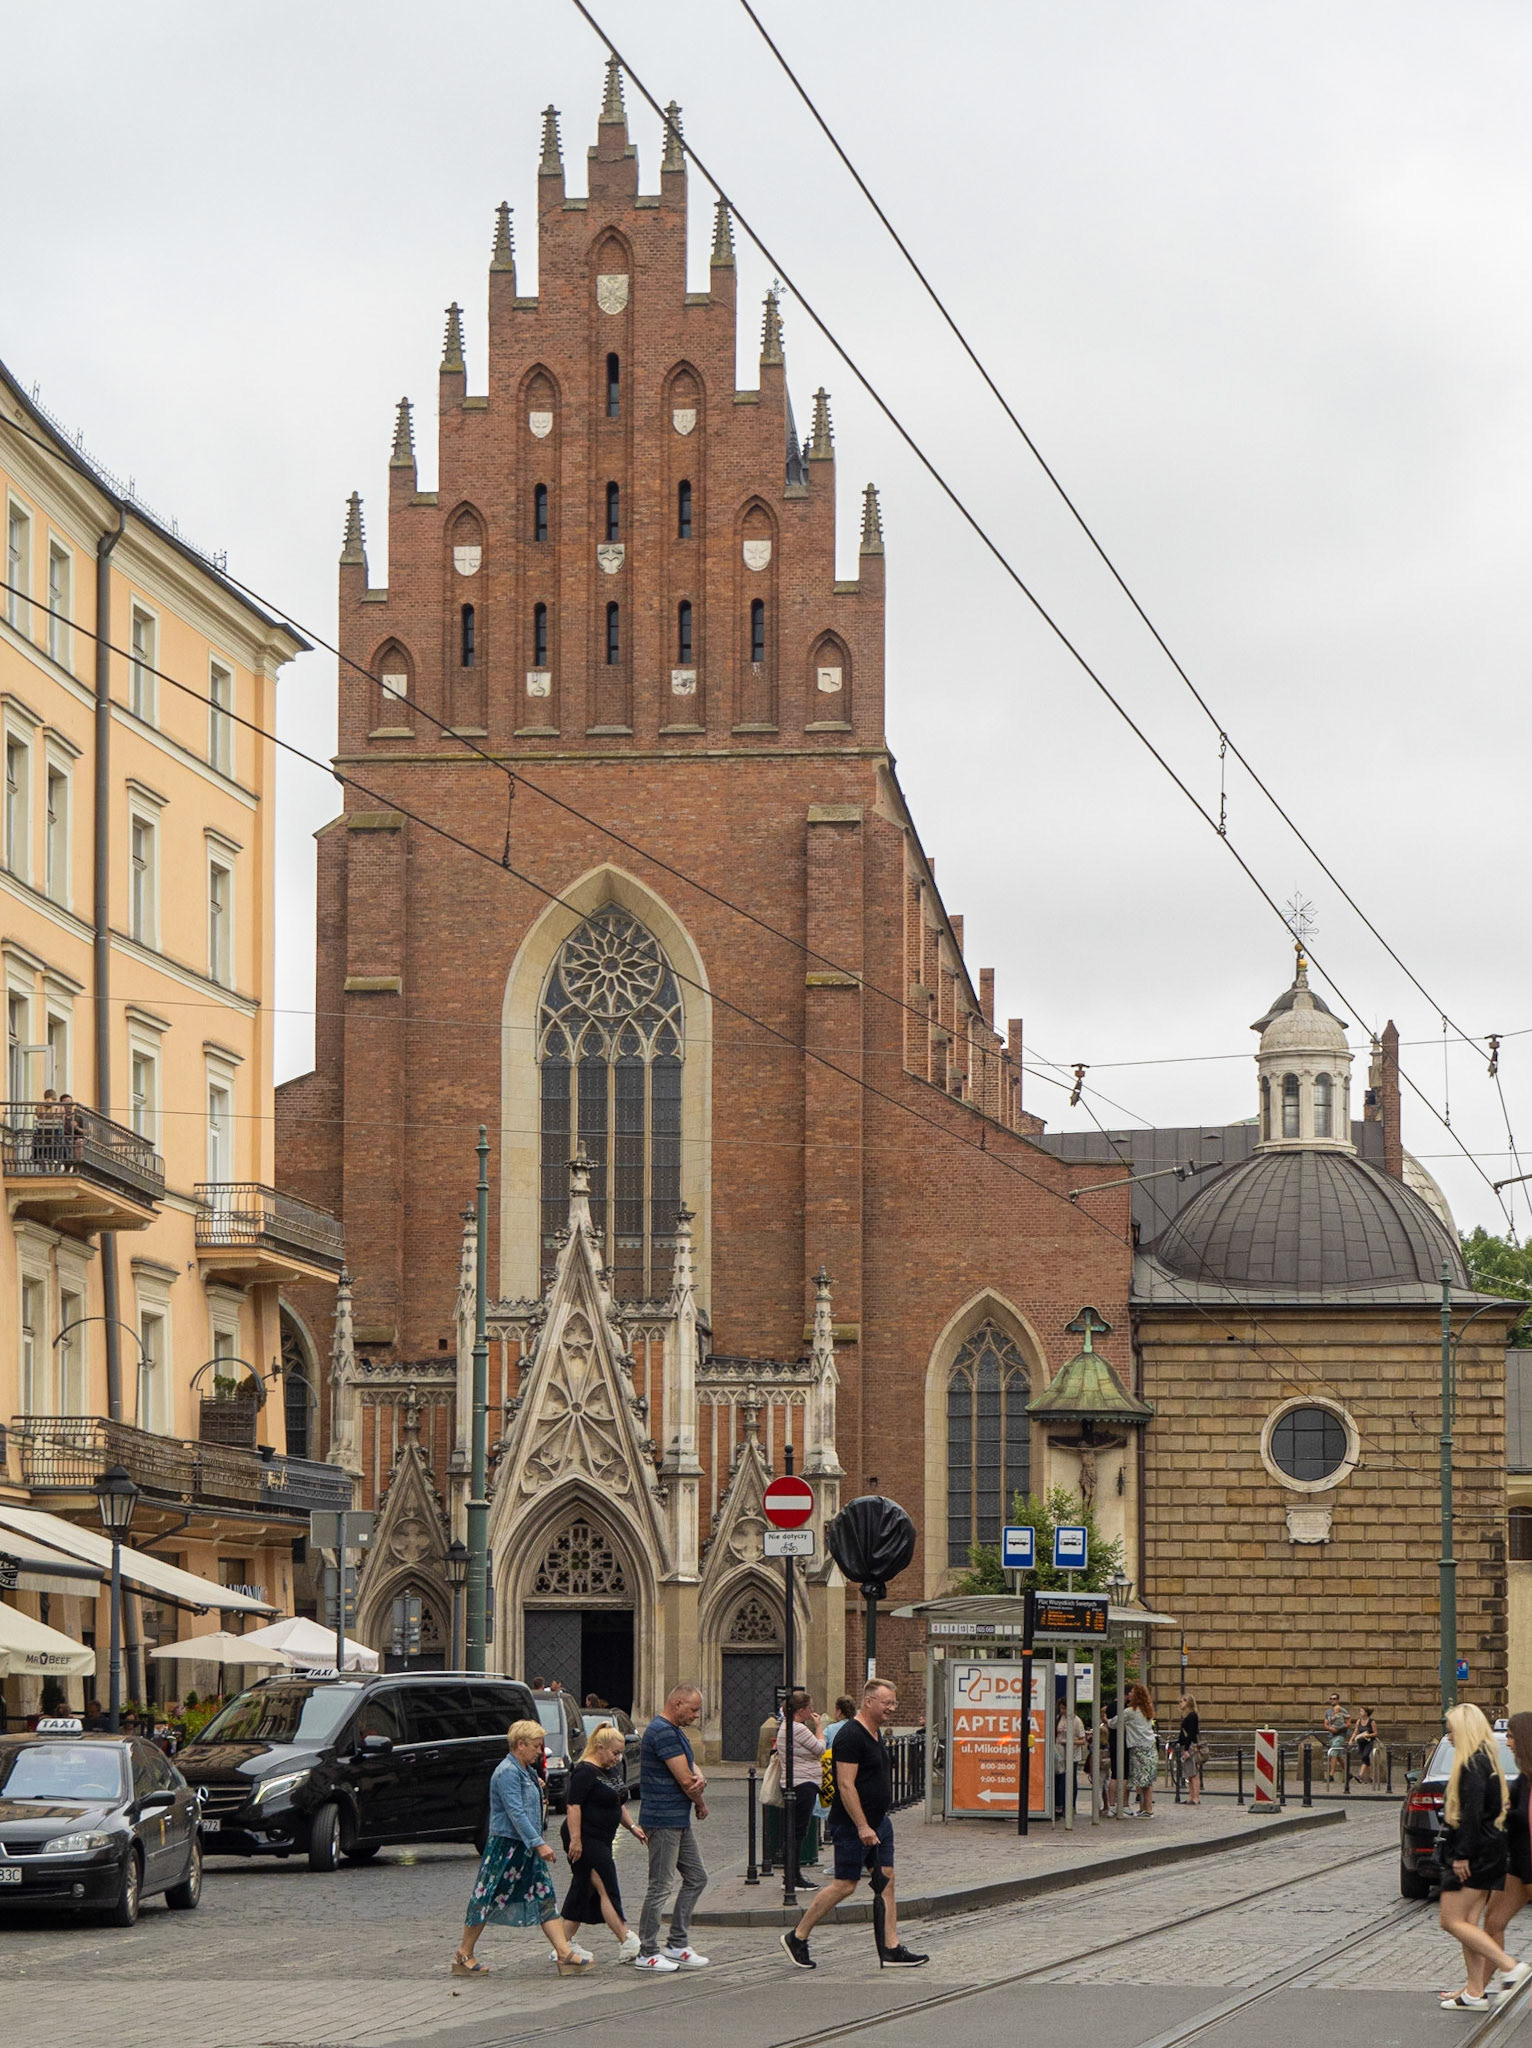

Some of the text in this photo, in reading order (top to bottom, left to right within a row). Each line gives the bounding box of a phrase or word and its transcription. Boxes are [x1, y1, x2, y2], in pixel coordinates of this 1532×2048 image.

[48, 1655, 71, 1665] BEEF
[309, 1668, 333, 1676] TAXI
[995, 1678, 1038, 1693] DOZ
[42, 1719, 76, 1729] TAXI
[955, 1715, 1040, 1732] APTEKA
[961, 1743, 973, 1753] ul.
[974, 1743, 1022, 1755] Mikołajsk
